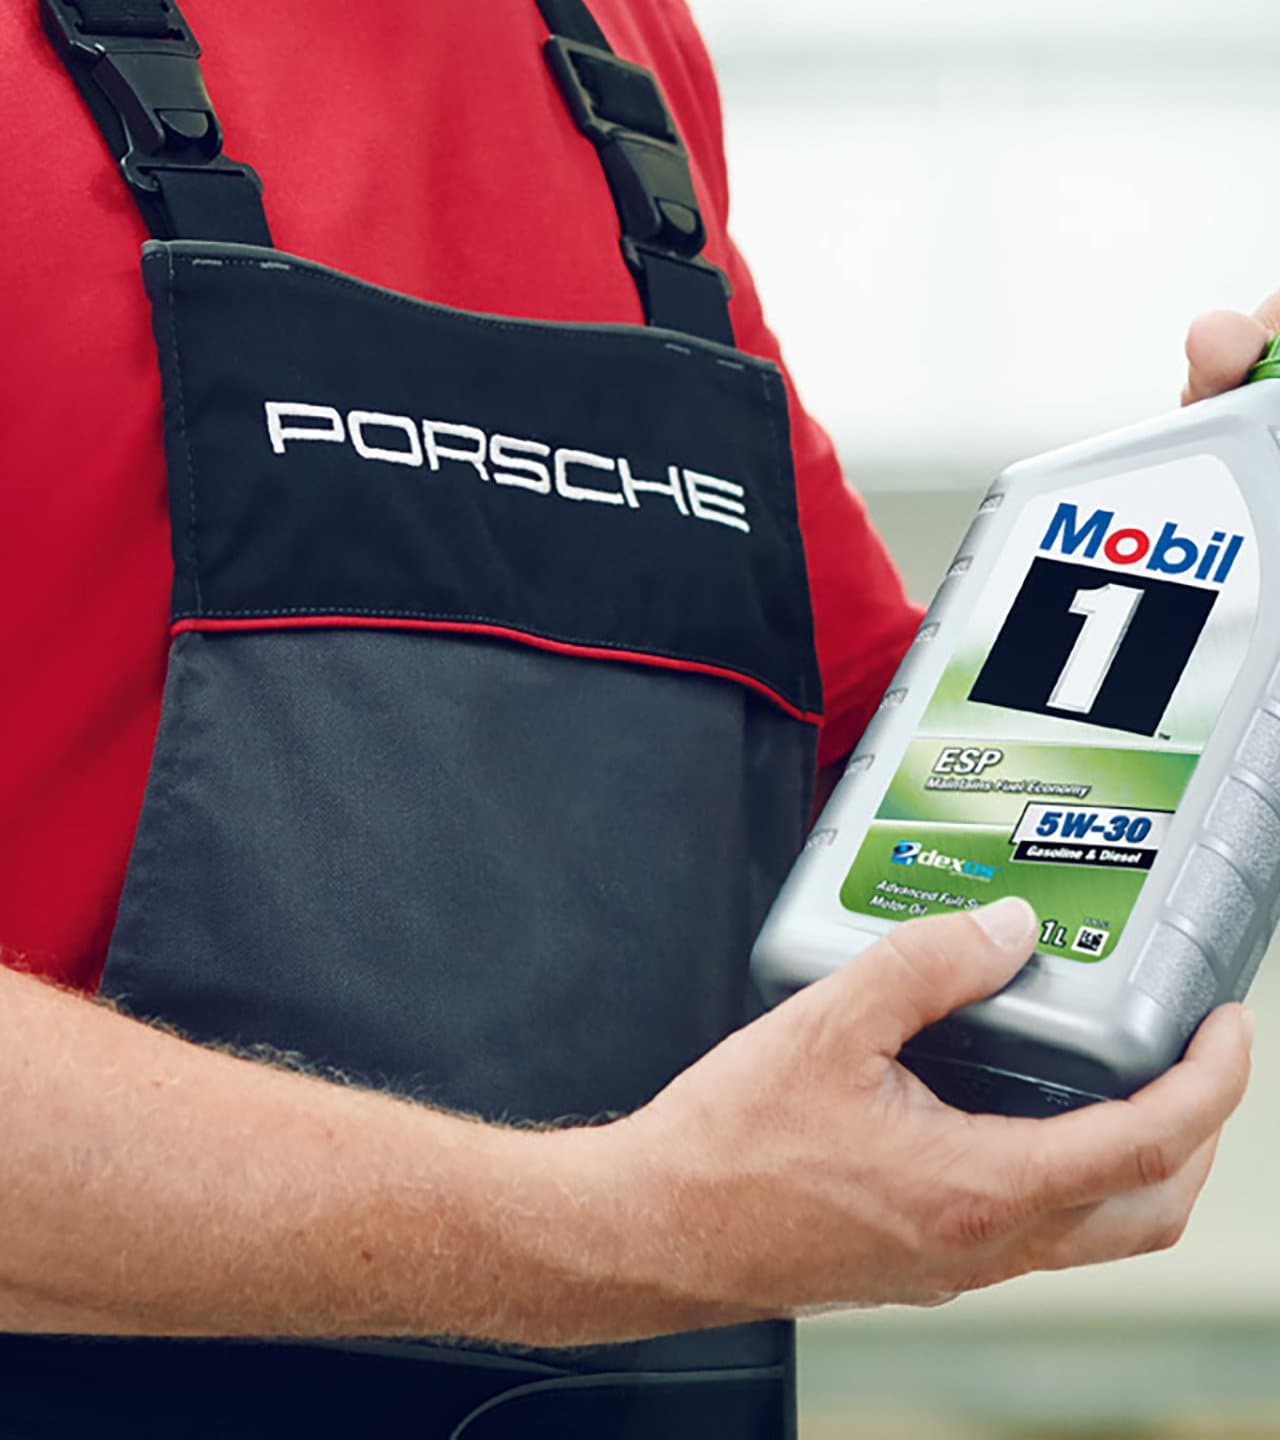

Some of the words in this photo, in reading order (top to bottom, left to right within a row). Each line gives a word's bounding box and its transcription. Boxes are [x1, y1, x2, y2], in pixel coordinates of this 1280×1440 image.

[264, 401, 750, 533] PORSCHE
[1039, 502, 1245, 584] Mobil
[1046, 582, 1146, 715] 1
[933, 747, 1003, 775] ESP
[925, 776, 992, 793] Maintains
[995, 778, 1026, 794] Fuel
[1027, 780, 1092, 799] Economy
[1035, 810, 1153, 844] 5W-30
[1026, 844, 1084, 860] Gasoline
[1084, 848, 1097, 860] &
[1099, 849, 1143, 864] Diesel
[869, 895, 908, 912] Motor
[908, 902, 928, 915] Oil
[875, 879, 939, 902] Advanced
[939, 892, 966, 907] Full
